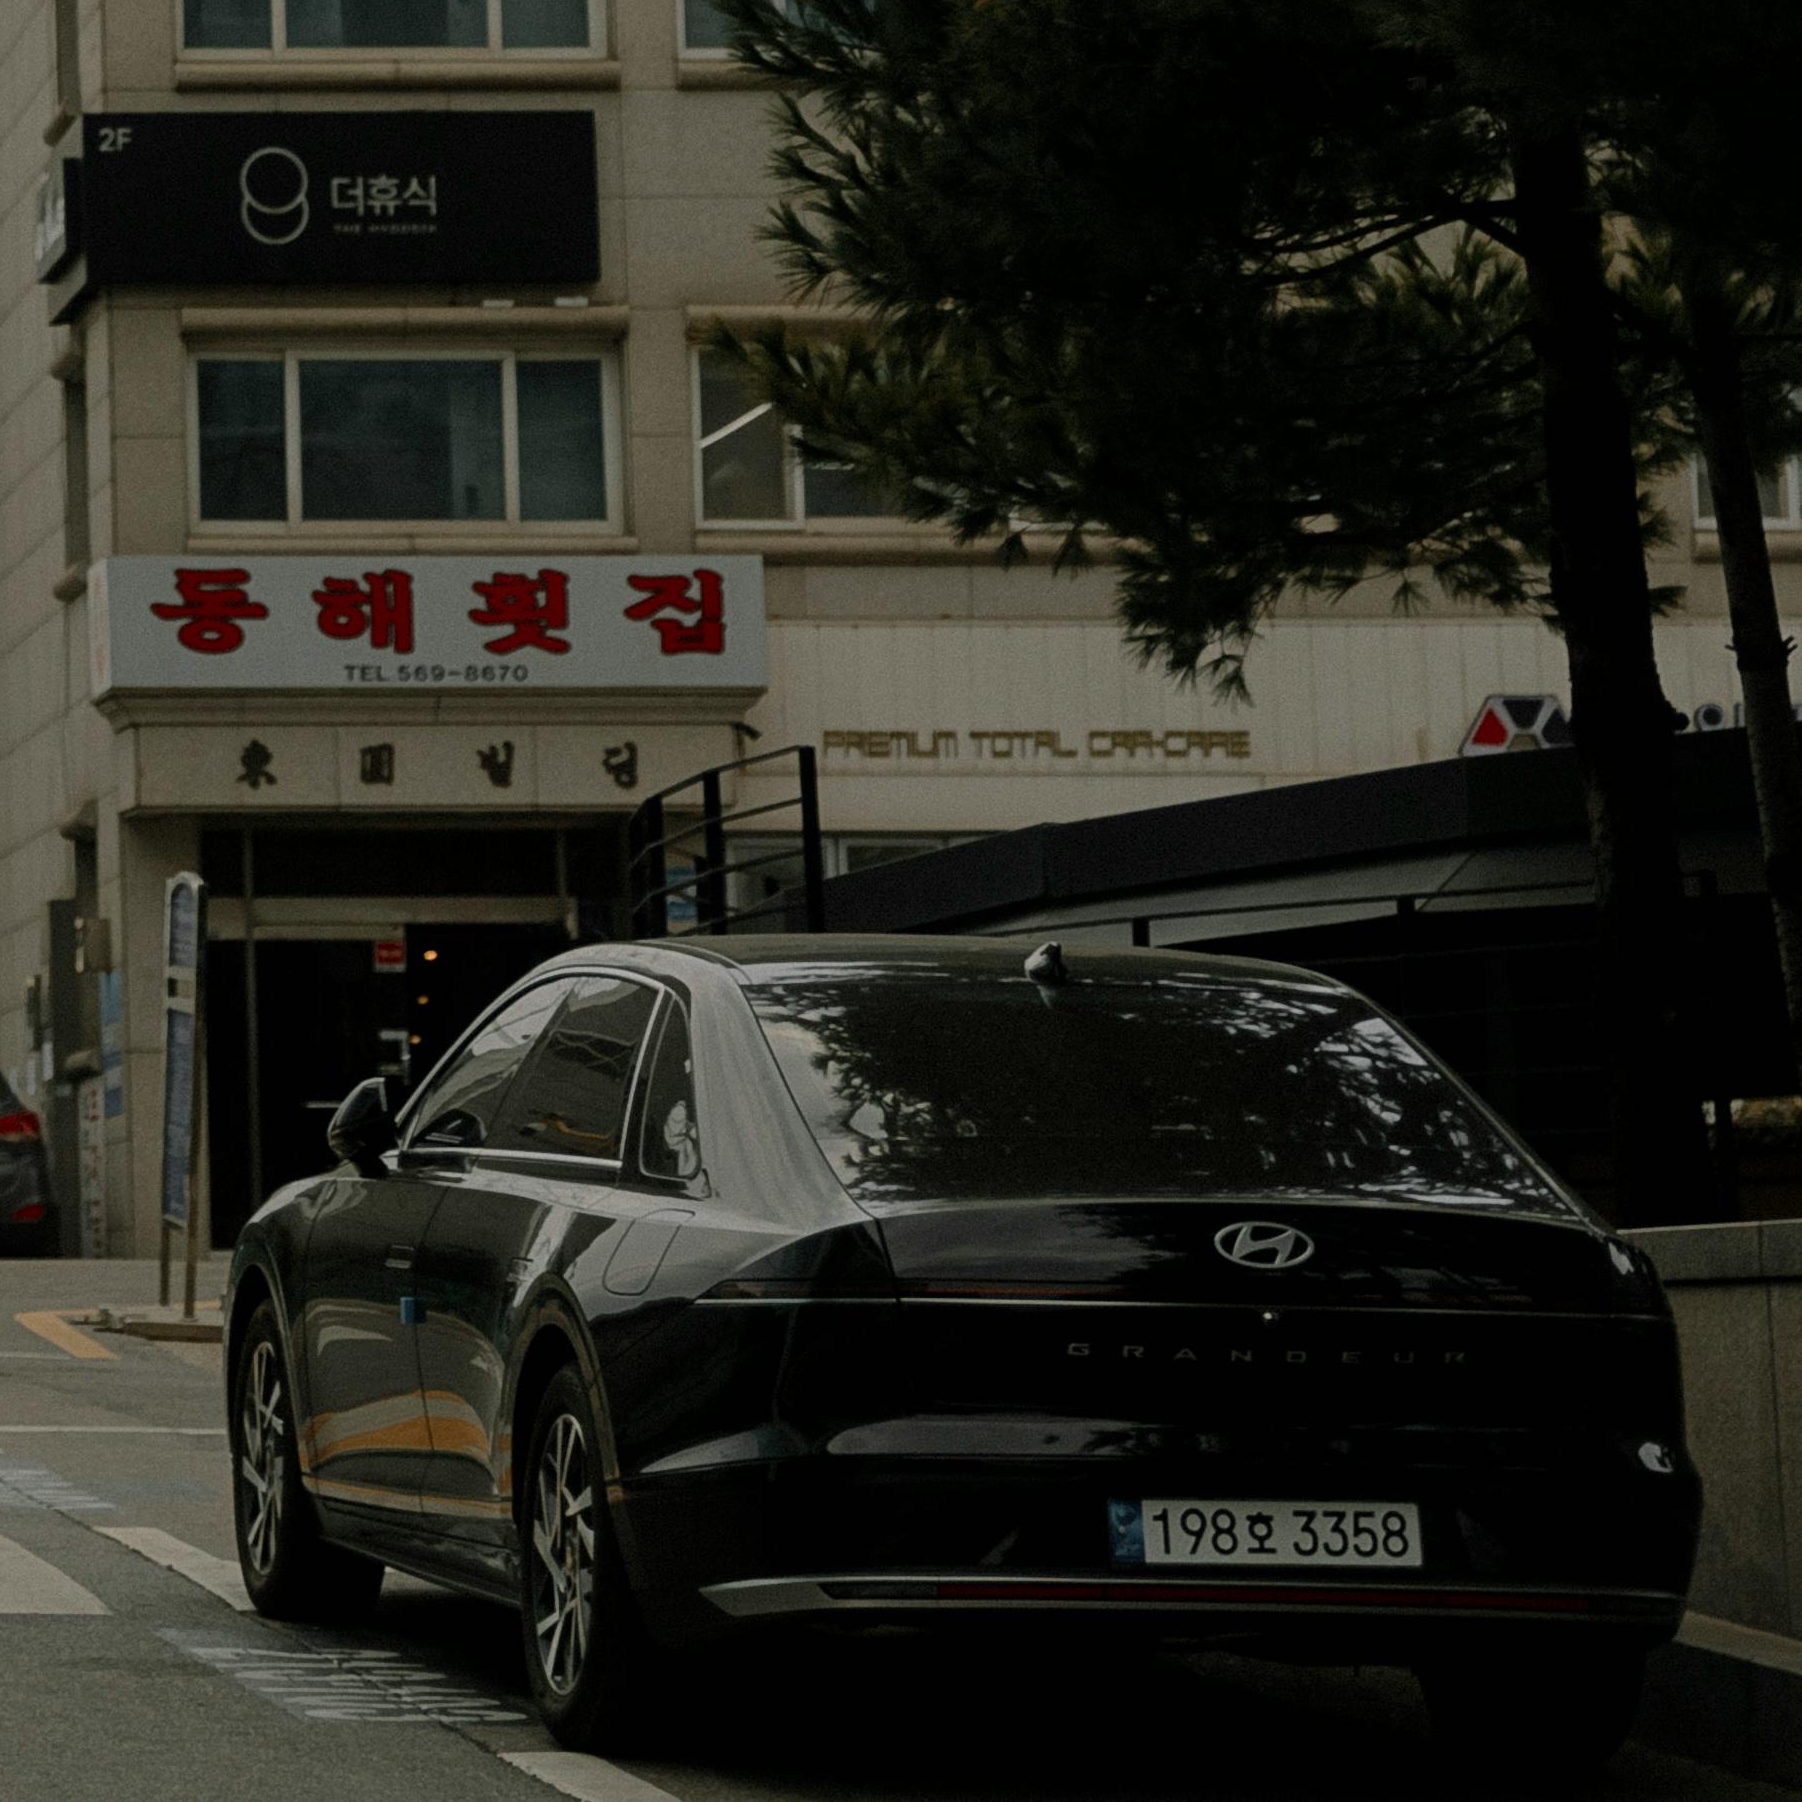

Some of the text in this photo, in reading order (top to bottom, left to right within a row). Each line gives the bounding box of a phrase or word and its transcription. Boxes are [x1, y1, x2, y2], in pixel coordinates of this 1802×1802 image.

[98, 128, 132, 153] 2F
[331, 174, 437, 217] 더휴식
[151, 568, 726, 654] 동해횟집
[398, 664, 528, 682] 569-8670
[969, 730, 1077, 759] TOTAL
[1067, 1342, 1467, 1365] GRANDEUR
[1152, 1508, 1409, 1557] 198호 3358
